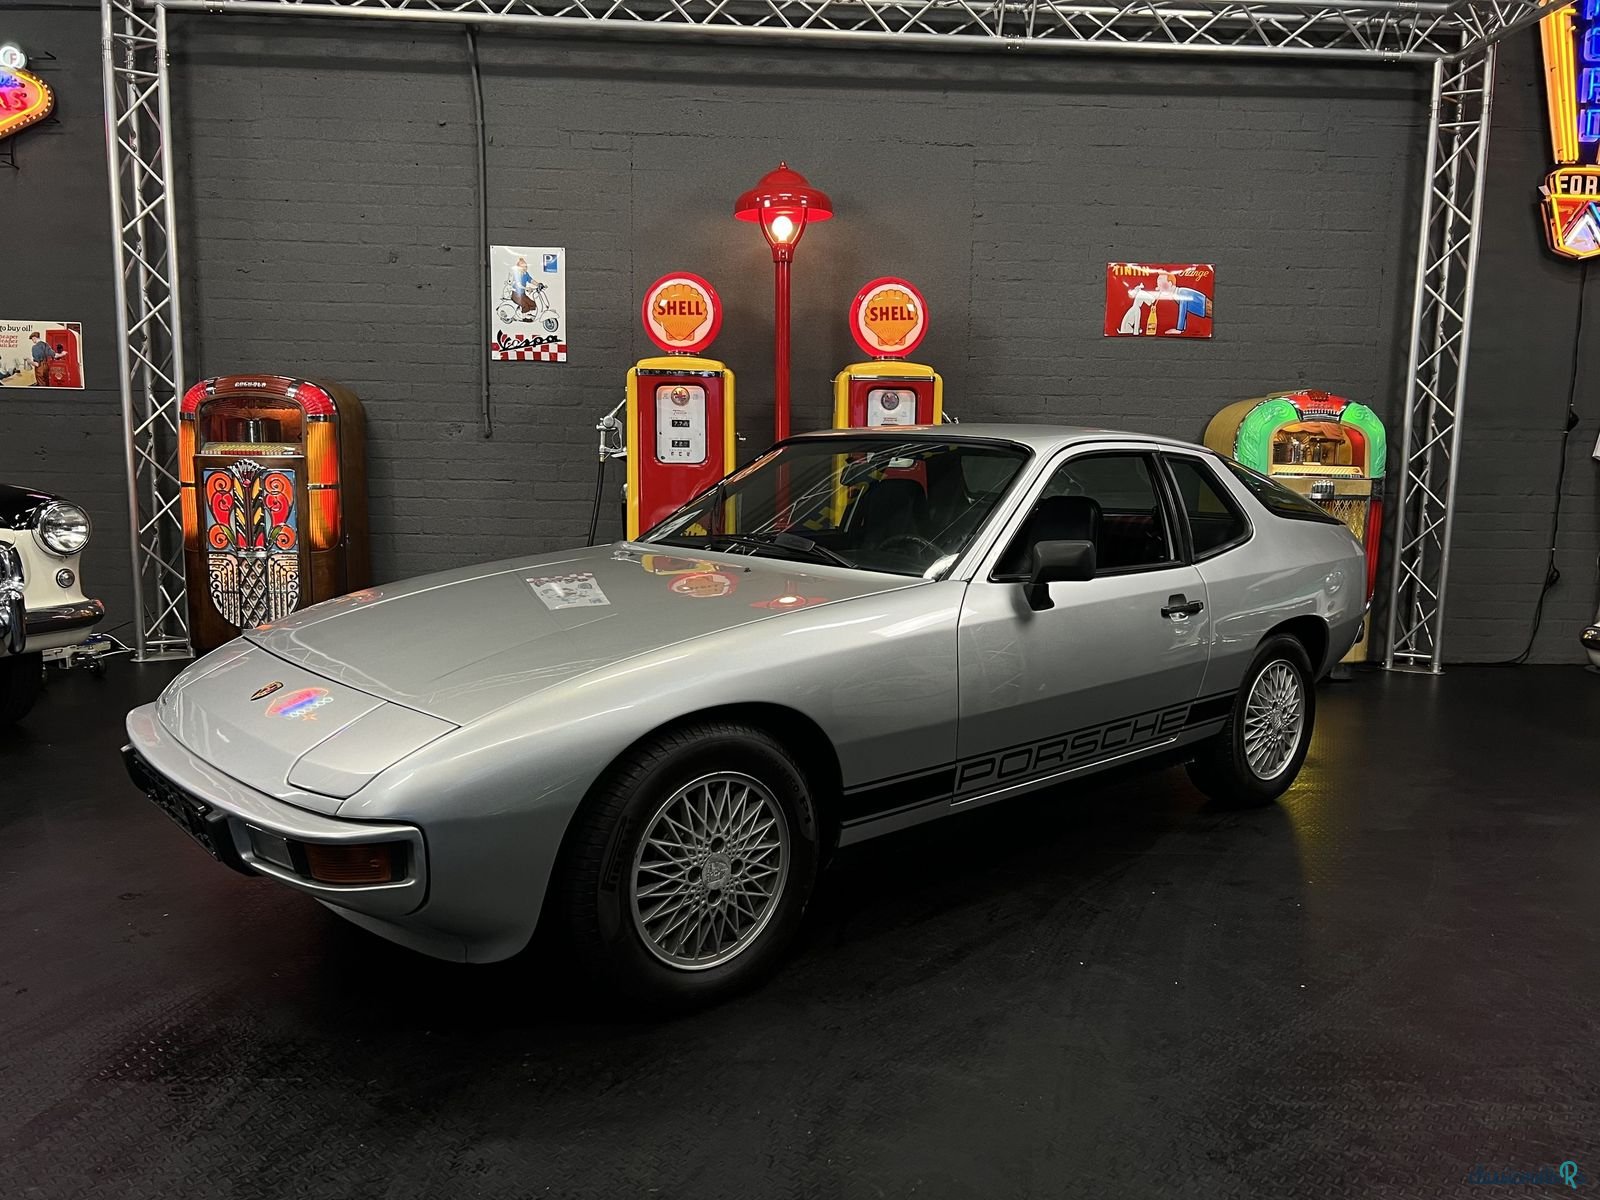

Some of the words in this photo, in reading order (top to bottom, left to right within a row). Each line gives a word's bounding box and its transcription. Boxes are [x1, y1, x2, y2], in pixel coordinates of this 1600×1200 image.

[1112, 264, 1150, 277] TINTIN
[657, 299, 704, 316] SHELL
[869, 305, 914, 322] SHELL
[7, 324, 21, 332] buy
[22, 324, 33, 332] oil!
[496, 329, 564, 353] Vespa
[956, 705, 1190, 790] PORSCHE
